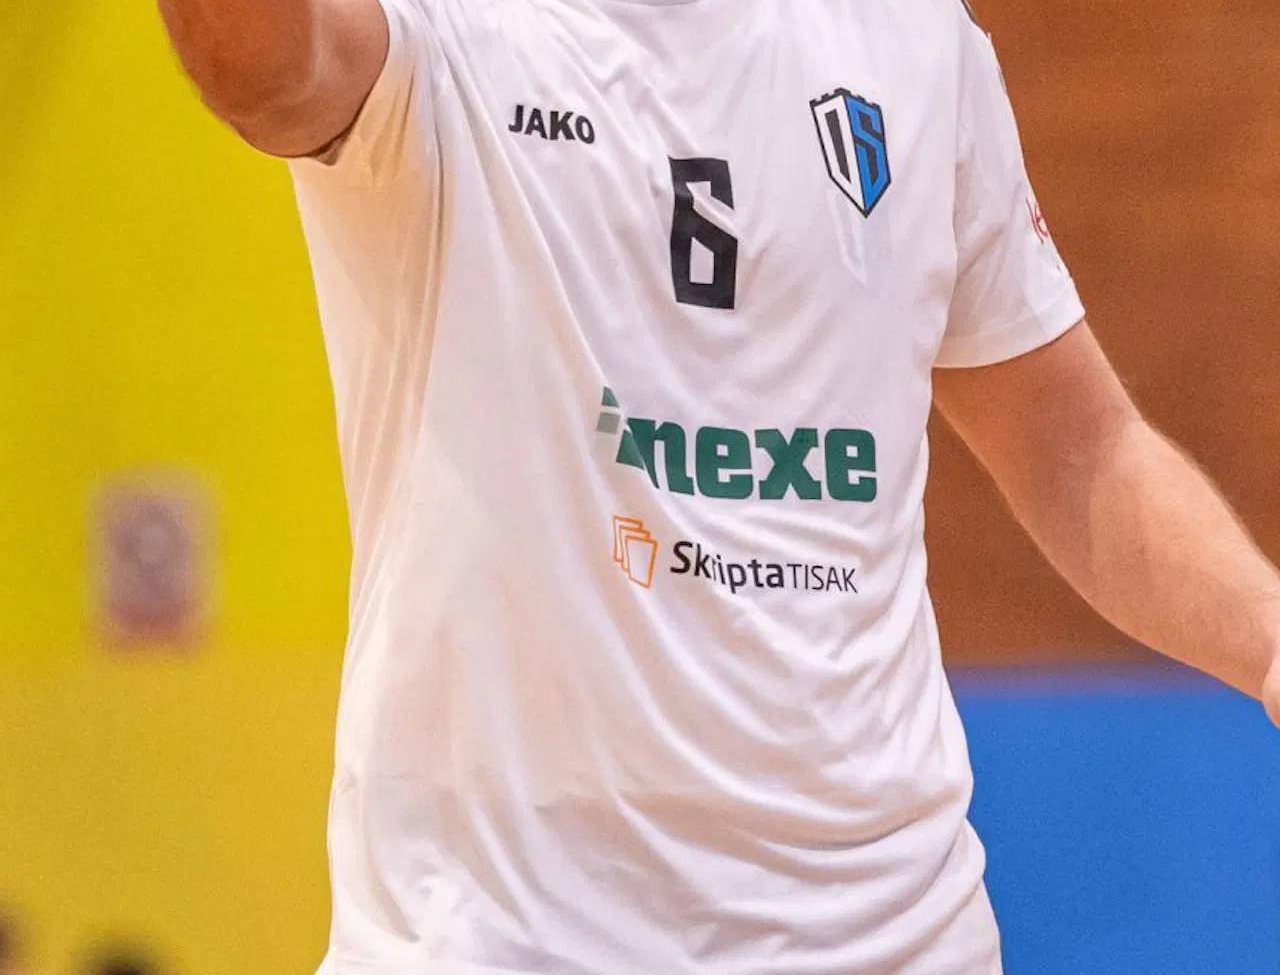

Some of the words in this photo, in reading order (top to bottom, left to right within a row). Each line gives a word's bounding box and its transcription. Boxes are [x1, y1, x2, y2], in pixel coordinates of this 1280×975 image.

[507, 104, 595, 144] JAKO
[668, 157, 738, 309] 6
[616, 416, 878, 502] nexe
